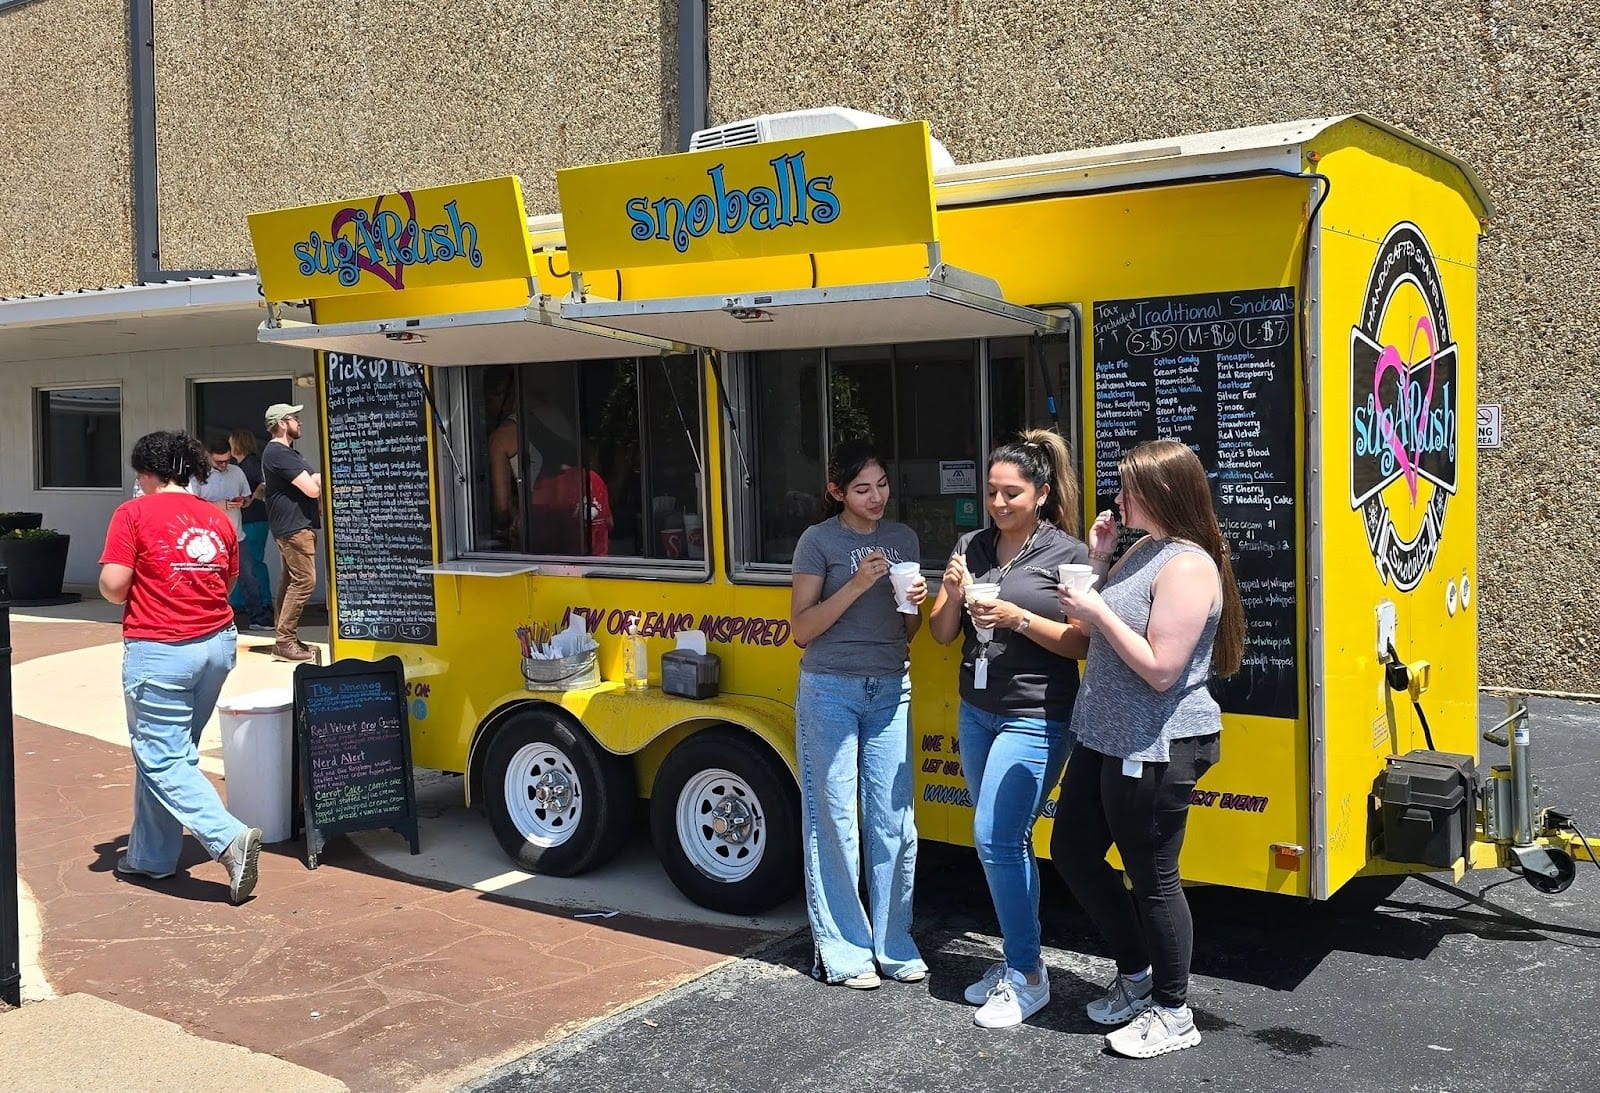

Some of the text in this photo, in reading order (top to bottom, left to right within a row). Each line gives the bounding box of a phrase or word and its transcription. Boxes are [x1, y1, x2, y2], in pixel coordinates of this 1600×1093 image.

[626, 150, 840, 253] snoballs
[1095, 304, 1119, 319] Tax
[1136, 293, 1295, 327] Traditional Snoballs
[1093, 308, 1137, 337] Included
[1153, 354, 1200, 366] Cotton Candy
[1216, 352, 1255, 362] Pineapple
[1096, 360, 1129, 372] Apple Pie
[1153, 364, 1199, 377] Cream Soda
[1217, 360, 1275, 371] Pink Lemonade
[1095, 371, 1128, 380] Banana
[1155, 376, 1195, 386] Dreamsicle
[1217, 370, 1274, 382] Red Raspberry
[1095, 380, 1147, 391] Bahama Mama
[1155, 384, 1202, 396] French Vanilla
[1096, 390, 1136, 401] Blackberry
[1217, 390, 1257, 401] Silver Fox
[1095, 400, 1151, 411] Blue Raspberry
[1155, 397, 1178, 406] Grape
[1095, 409, 1143, 419] Butterscotch
[1155, 403, 1198, 415] Green Apple
[1156, 413, 1195, 424] Ice Cream
[1217, 411, 1256, 421] Spearmint
[1096, 419, 1137, 429] Bubblegum
[1157, 424, 1192, 435] Key Lime
[1217, 420, 1261, 432] Strawberry
[1095, 427, 1139, 438] Cake Batter
[1218, 429, 1260, 439] Red Velvet
[1095, 439, 1121, 450] Cherry
[1217, 440, 1254, 450] Tangerine
[1247, 449, 1271, 458] Blood
[1217, 460, 1262, 469] Watermelon
[1253, 470, 1275, 480] Cake
[1096, 479, 1118, 487] Coffee
[1222, 484, 1264, 497] SF Cherry
[1222, 495, 1294, 511] SF Wedding Cake
[698, 614, 791, 648] INSPIRED
[329, 720, 357, 733] Velvet
[921, 734, 945, 753] WE
[312, 750, 365, 769] Nerd Alert
[921, 758, 960, 776] LET US
[314, 787, 342, 801] Carrot
[343, 785, 363, 797] Cake
[1219, 792, 1269, 813] EVENT!
